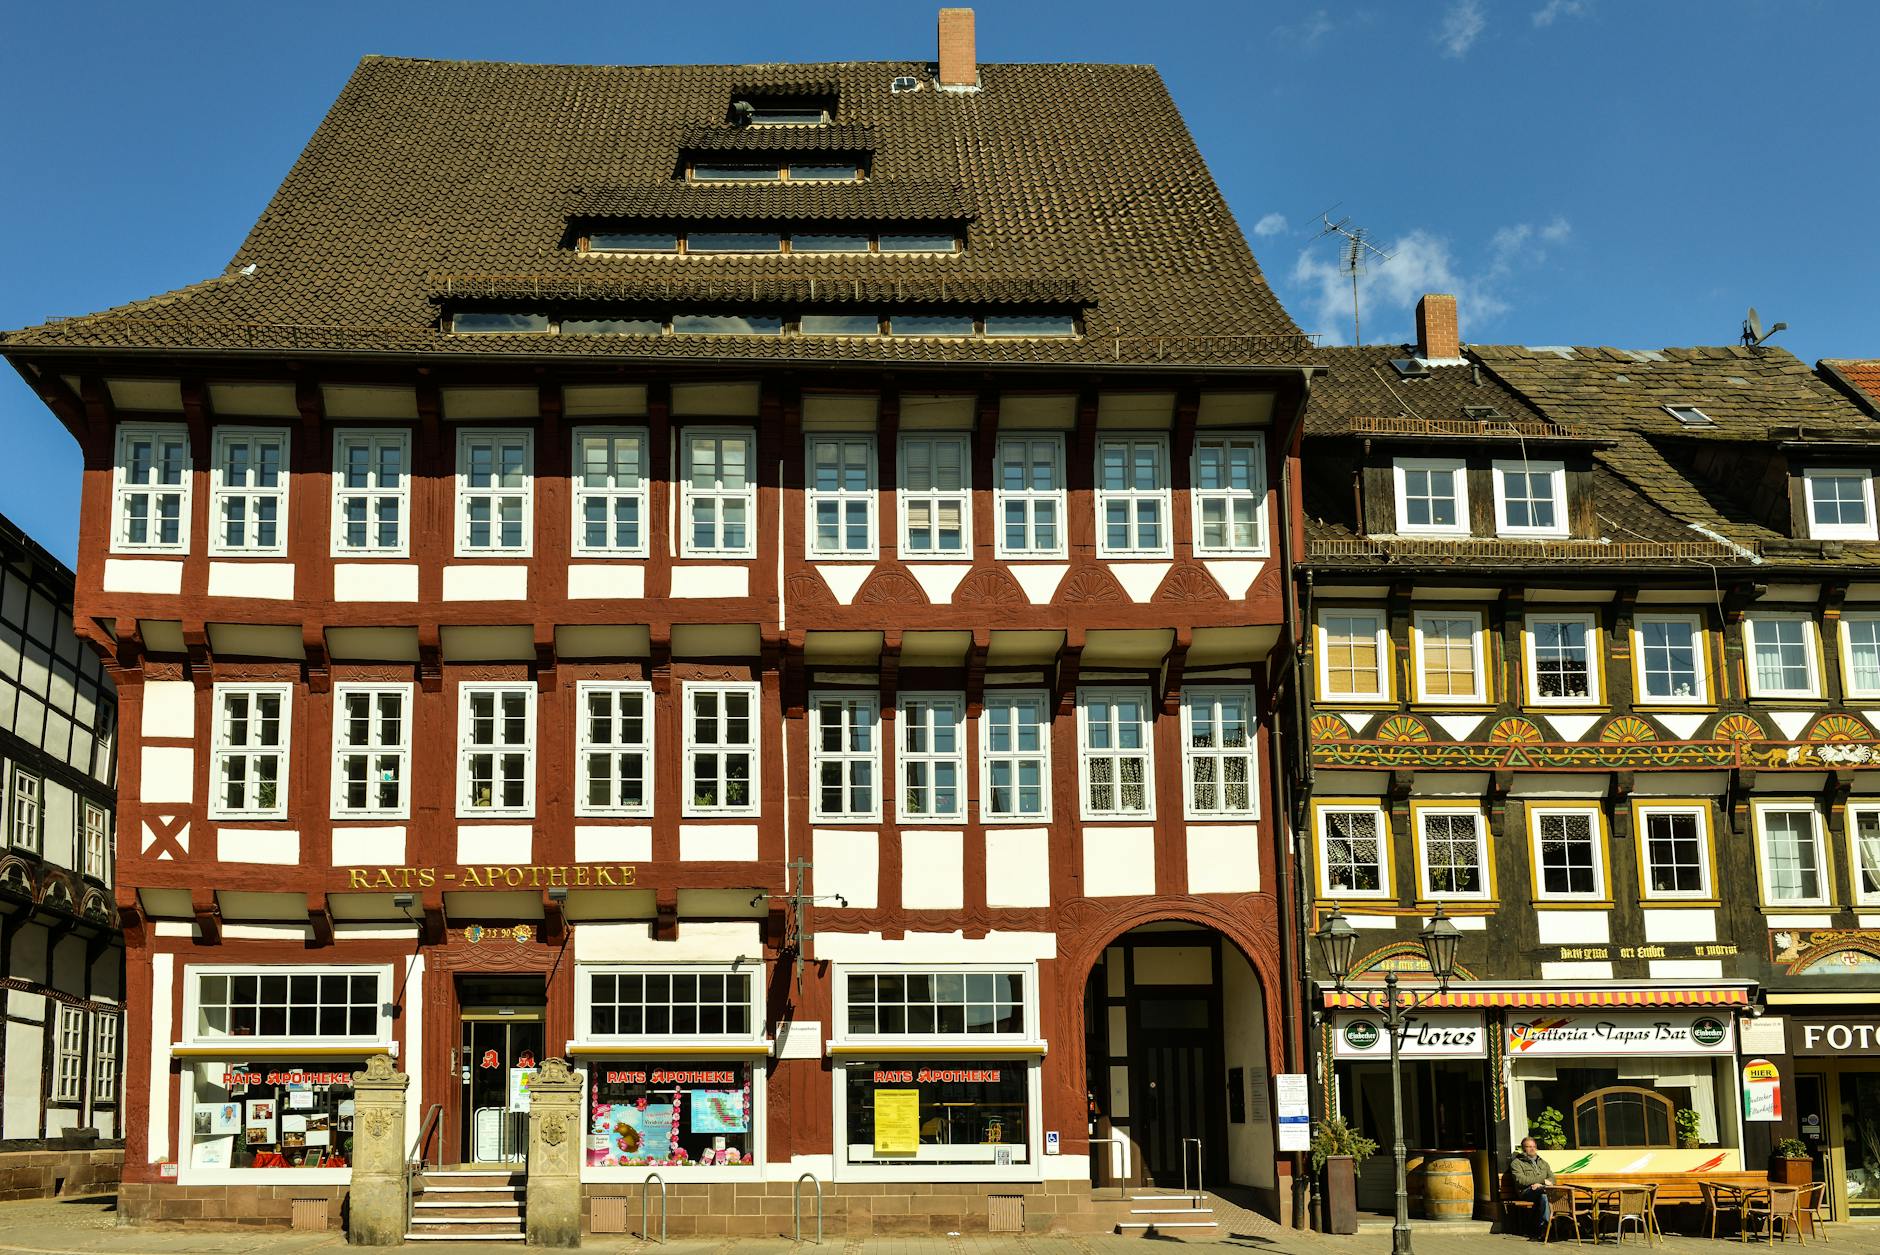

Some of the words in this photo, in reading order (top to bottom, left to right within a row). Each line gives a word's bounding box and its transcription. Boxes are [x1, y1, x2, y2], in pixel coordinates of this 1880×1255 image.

[348, 867, 435, 889] RATS
[459, 866, 637, 888] APOTHEKE
[1397, 1017, 1477, 1050] Flores
[1803, 1024, 1880, 1049] FOT
[222, 1072, 261, 1085] RATS
[266, 1069, 351, 1085] APOTHEKE
[606, 1071, 647, 1084] RATS
[650, 1068, 735, 1084] APOTHEKE
[873, 1070, 913, 1083] RATS
[916, 1068, 1001, 1083] APOTHEKE
[1750, 1069, 1772, 1077] HIER
